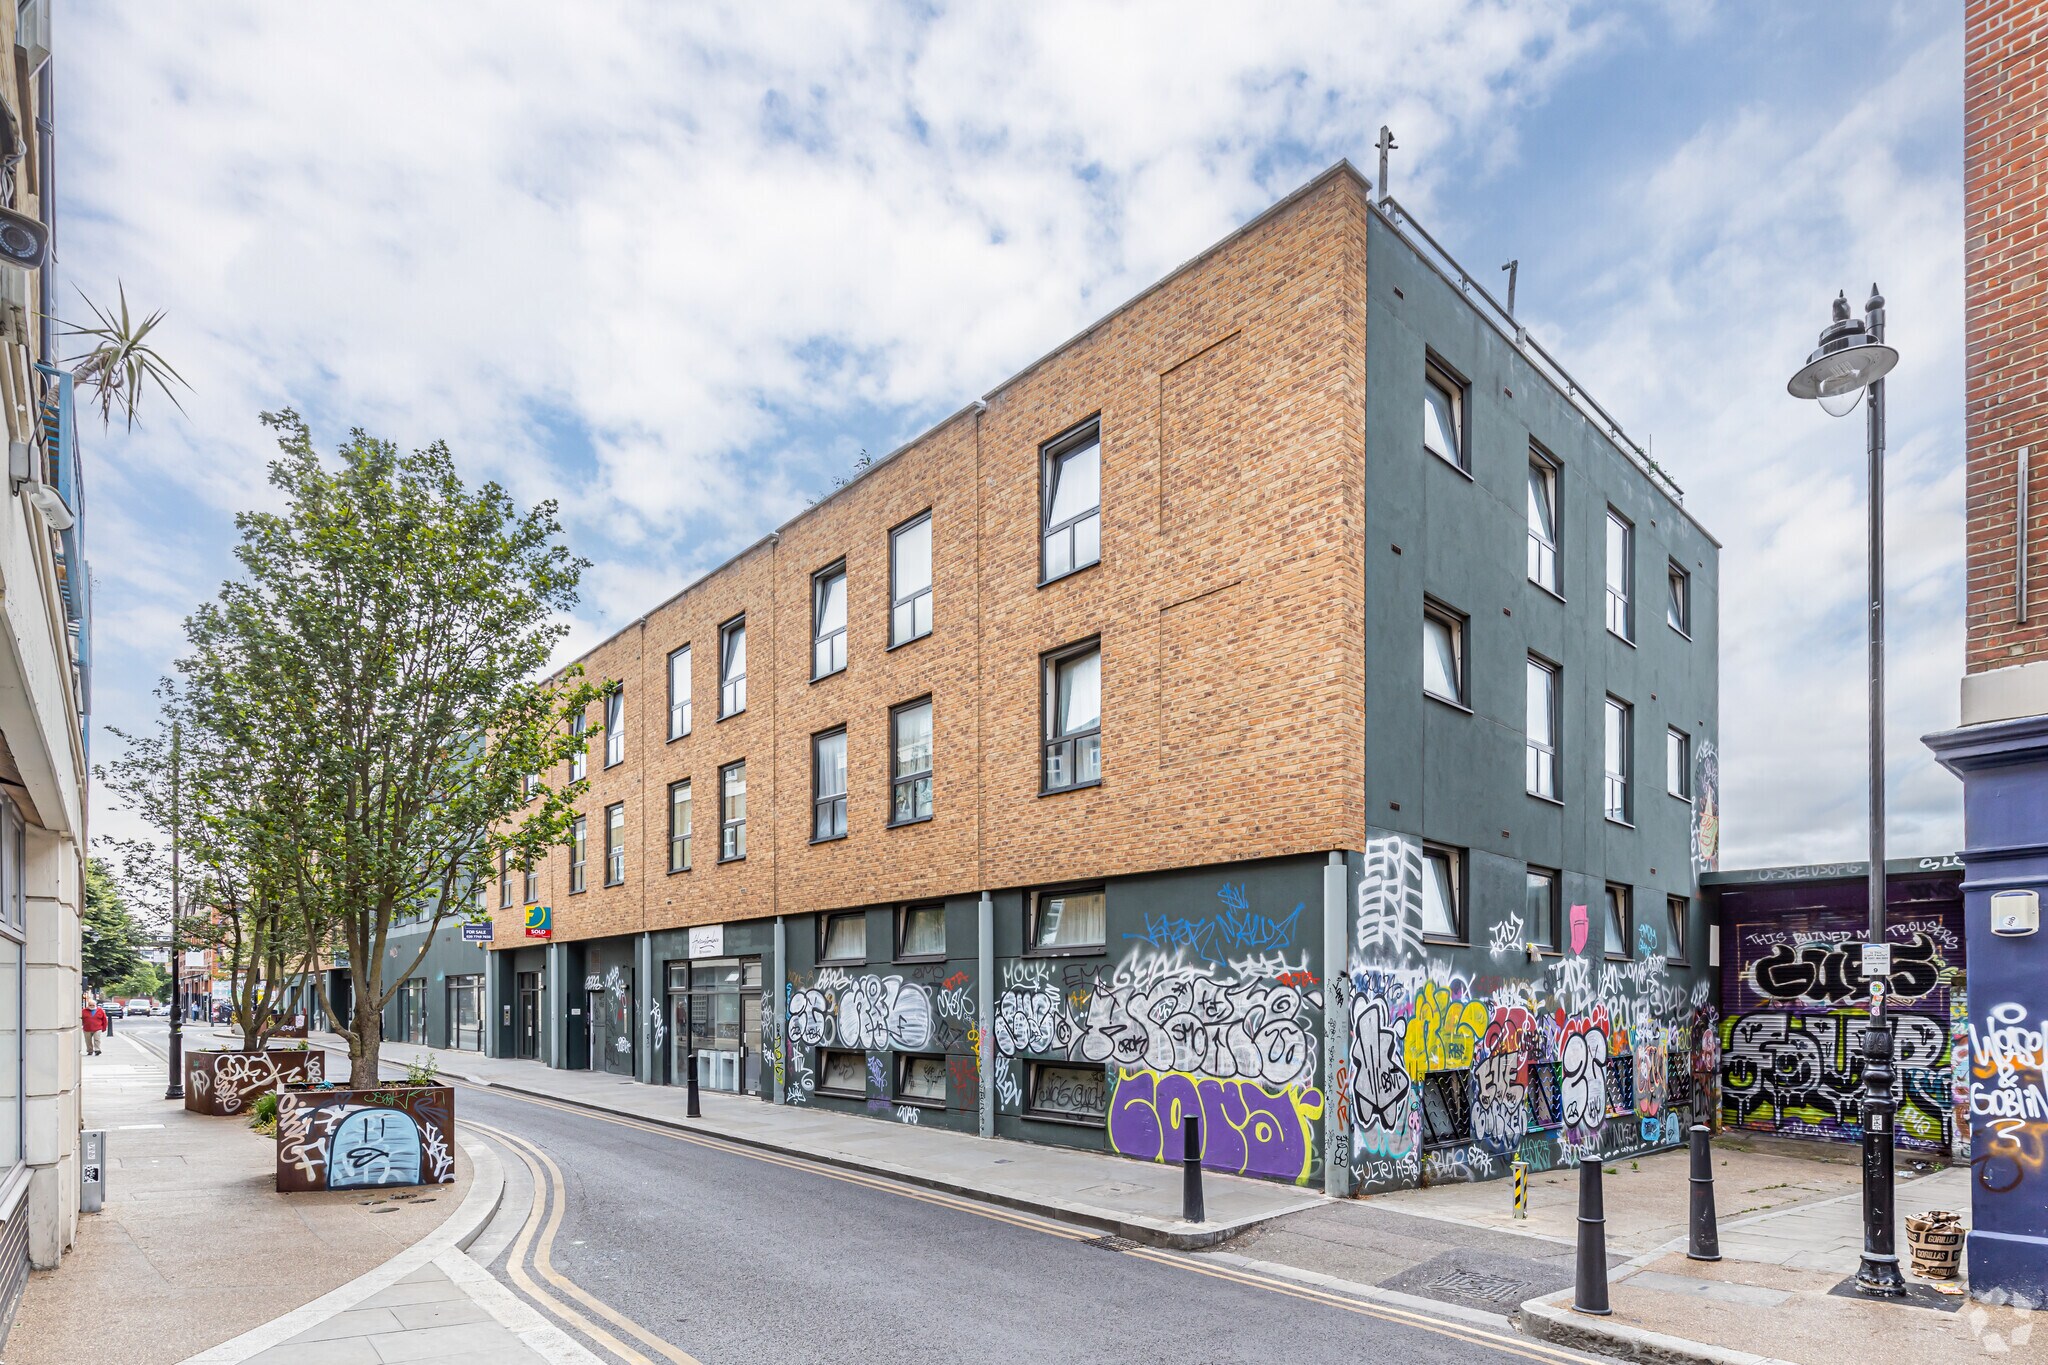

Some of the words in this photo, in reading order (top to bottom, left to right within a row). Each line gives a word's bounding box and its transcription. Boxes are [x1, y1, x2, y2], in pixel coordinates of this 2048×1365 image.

[1745, 931, 1787, 946] THIS
[1793, 930, 1852, 947] RUINED
[1887, 921, 1959, 950] TROUSERS
[1928, 1235, 1956, 1244] GORILLAS
[1917, 1249, 1946, 1260] GORILLAS
